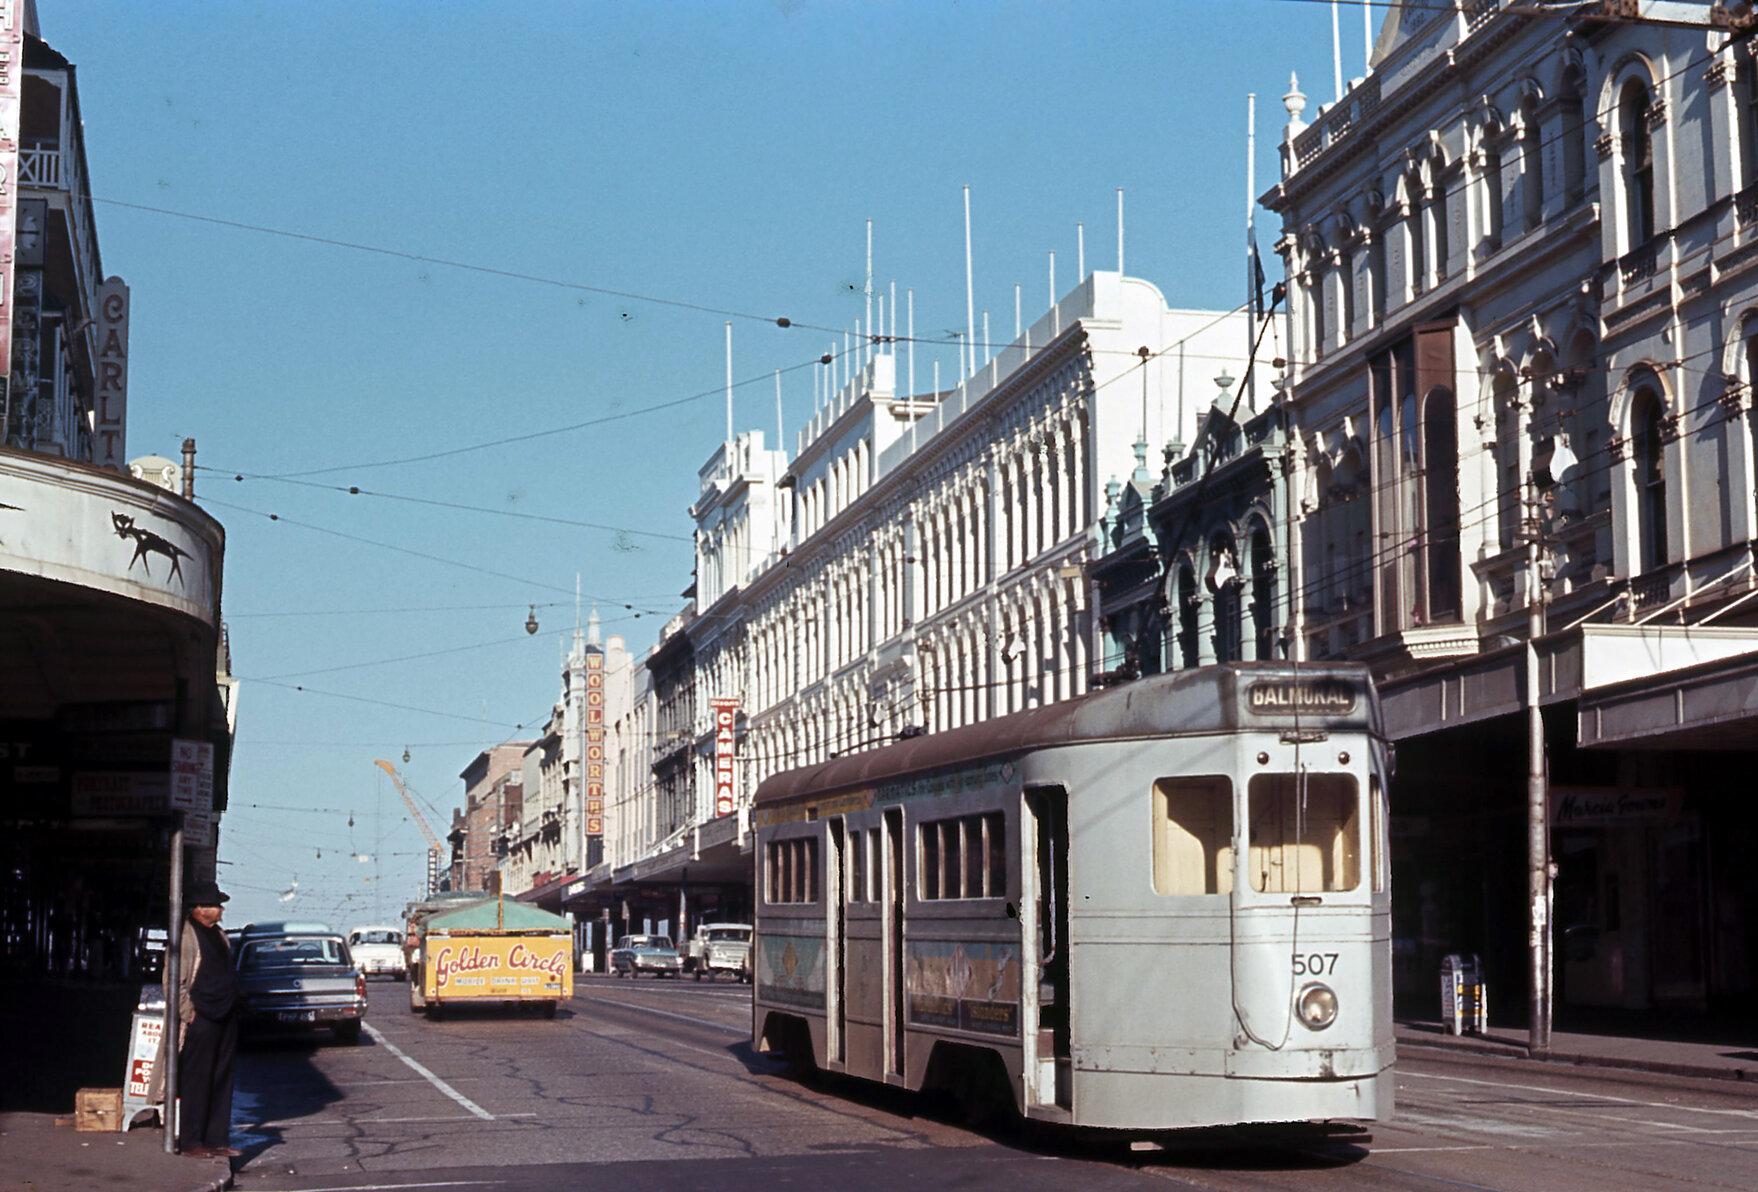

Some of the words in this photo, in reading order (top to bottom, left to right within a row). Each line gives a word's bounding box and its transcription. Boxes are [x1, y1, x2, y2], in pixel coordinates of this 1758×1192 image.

[1253, 685, 1350, 705] BALMORAL
[588, 656, 603, 833] WOOLWORTHS
[718, 712, 732, 813] CAMERAS
[437, 946, 500, 987] Golden
[508, 943, 567, 976] Circle
[1292, 953, 1339, 976] 507
[141, 1022, 161, 1030] REA
